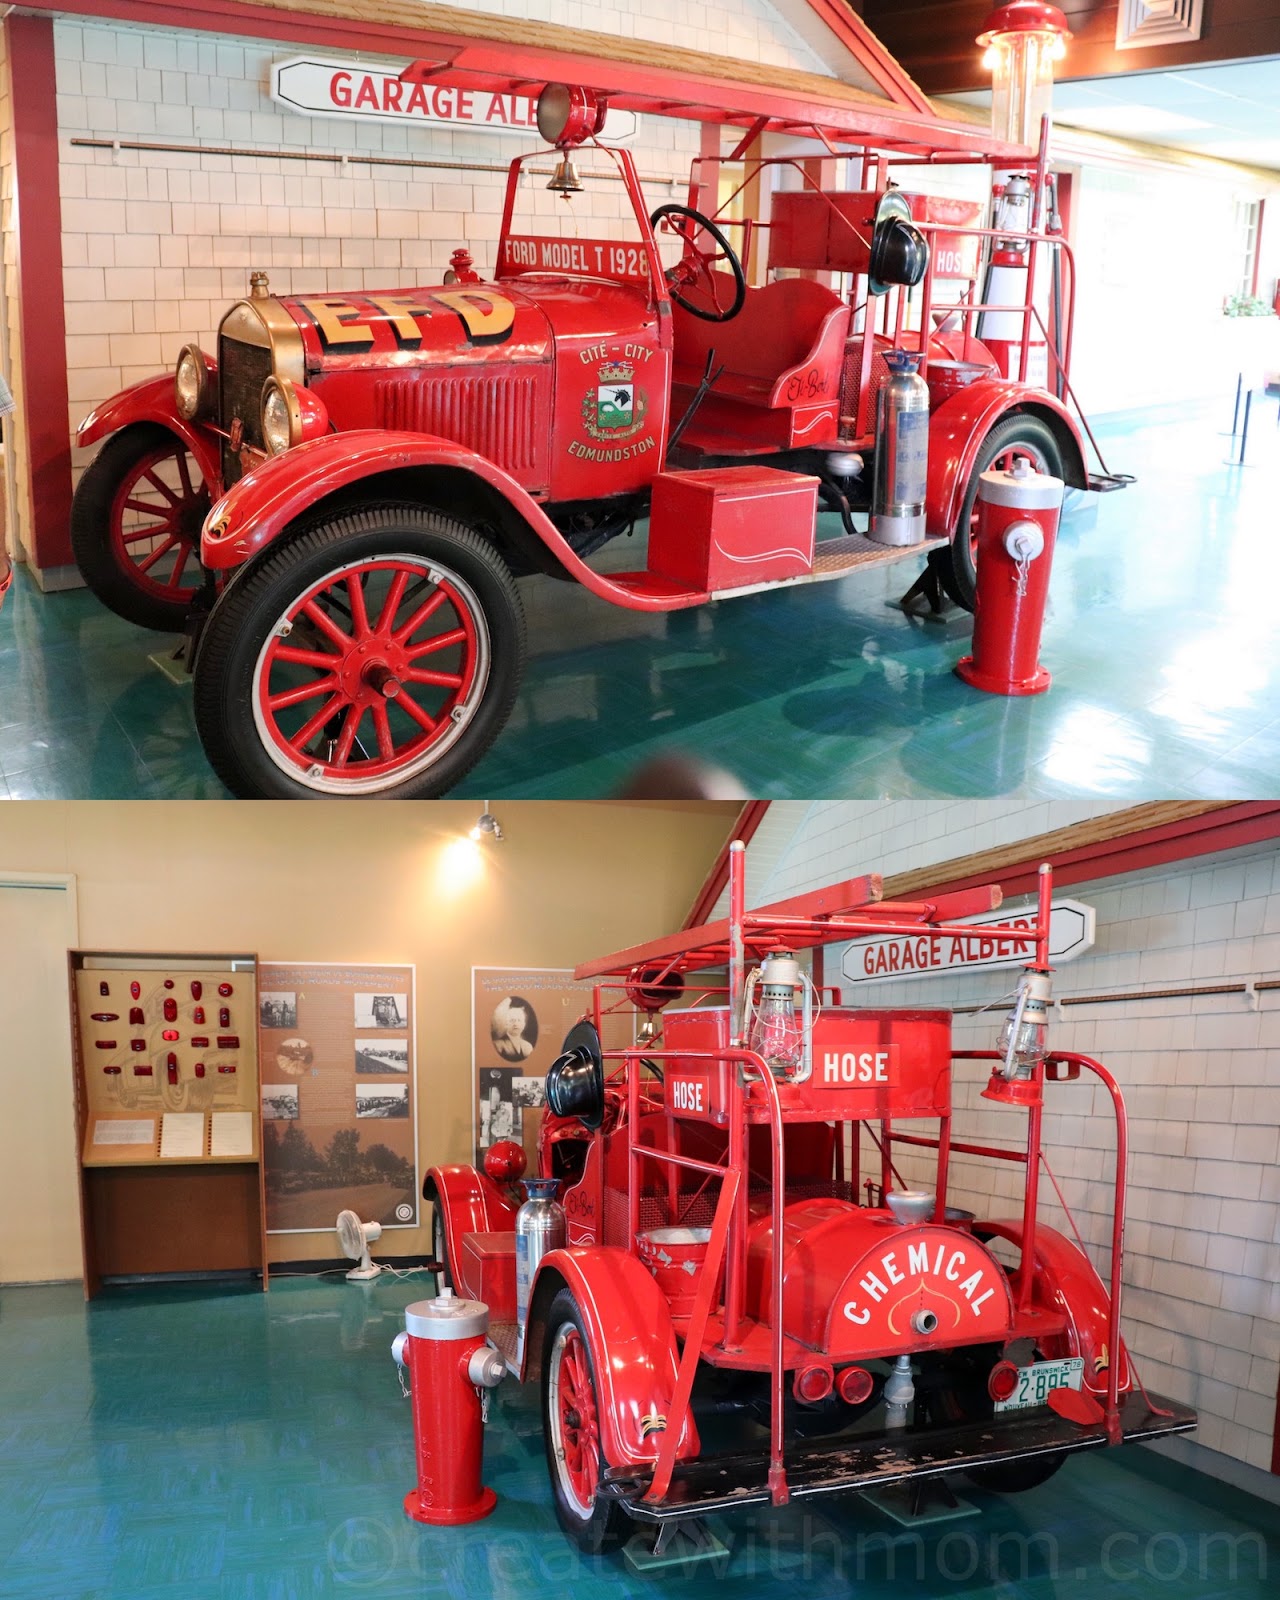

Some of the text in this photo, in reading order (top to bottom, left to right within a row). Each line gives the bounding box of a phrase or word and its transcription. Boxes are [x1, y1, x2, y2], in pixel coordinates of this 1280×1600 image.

[330, 72, 473, 118] GARAGE
[505, 240, 649, 276] FORD MODEL T 1928
[936, 251, 962, 273] HOS
[299, 290, 516, 351] EFD
[579, 340, 608, 364] CITÉ
[624, 343, 653, 362] CITY
[567, 435, 655, 462] EDMUNDSTON
[864, 936, 941, 975] GARAGE
[824, 1052, 889, 1083] HOSE
[673, 1081, 704, 1112] HOSE
[843, 1241, 995, 1325] CHEMICAL
[1032, 1366, 1069, 1377] BRUNSWICK
